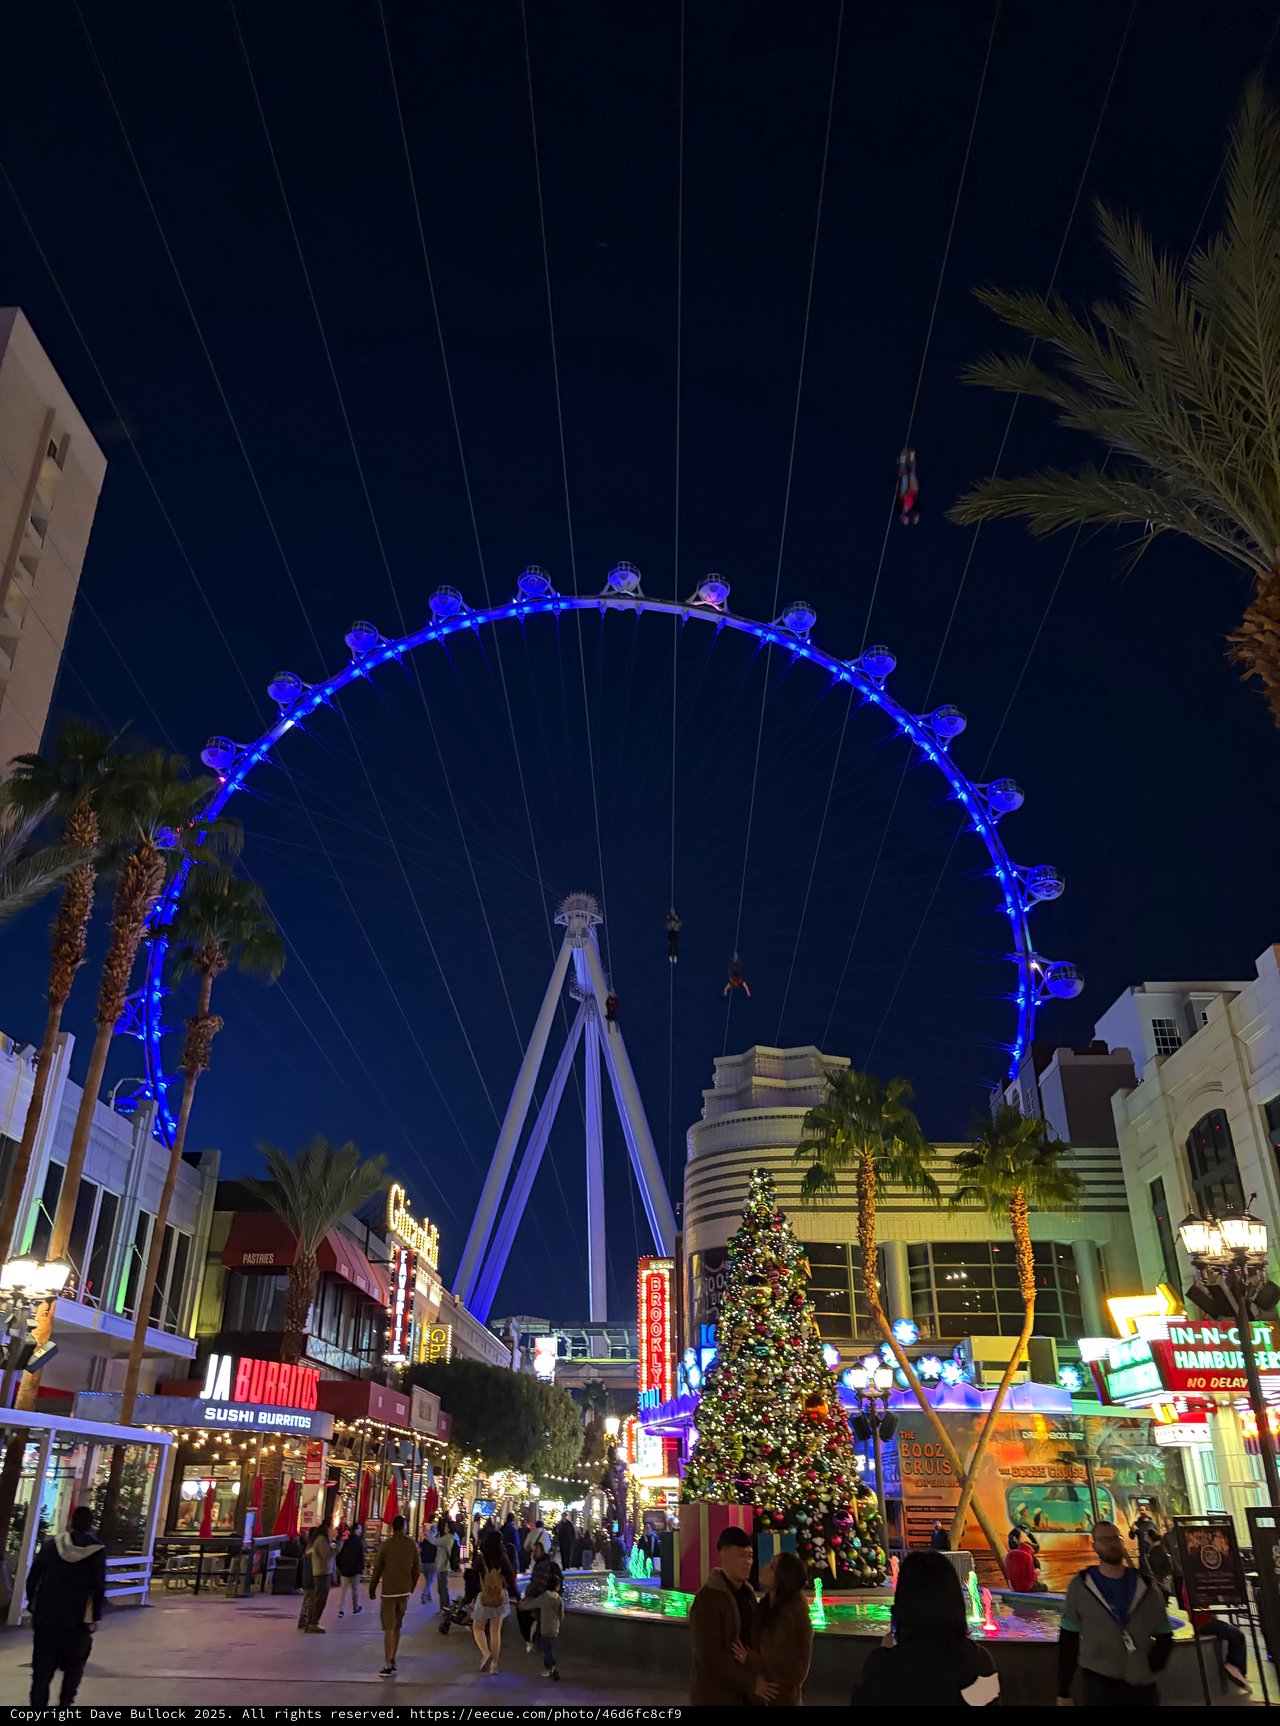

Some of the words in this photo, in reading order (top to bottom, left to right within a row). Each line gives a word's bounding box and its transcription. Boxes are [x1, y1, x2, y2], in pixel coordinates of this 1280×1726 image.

[243, 1253, 274, 1264] PASTRIES
[200, 1354, 232, 1401] JA
[234, 1356, 320, 1410] BURRITOS
[1187, 1377, 1207, 1388] NO
[1210, 1377, 1248, 1388] DELAY
[204, 1407, 254, 1423] SUSHI
[258, 1412, 312, 1428] BURRITOS
[900, 1431, 915, 1440] THE
[901, 1443, 945, 1458] BOOZ
[902, 1459, 952, 1475] CRUIS
[1011, 1465, 1046, 1478] BOOZE
